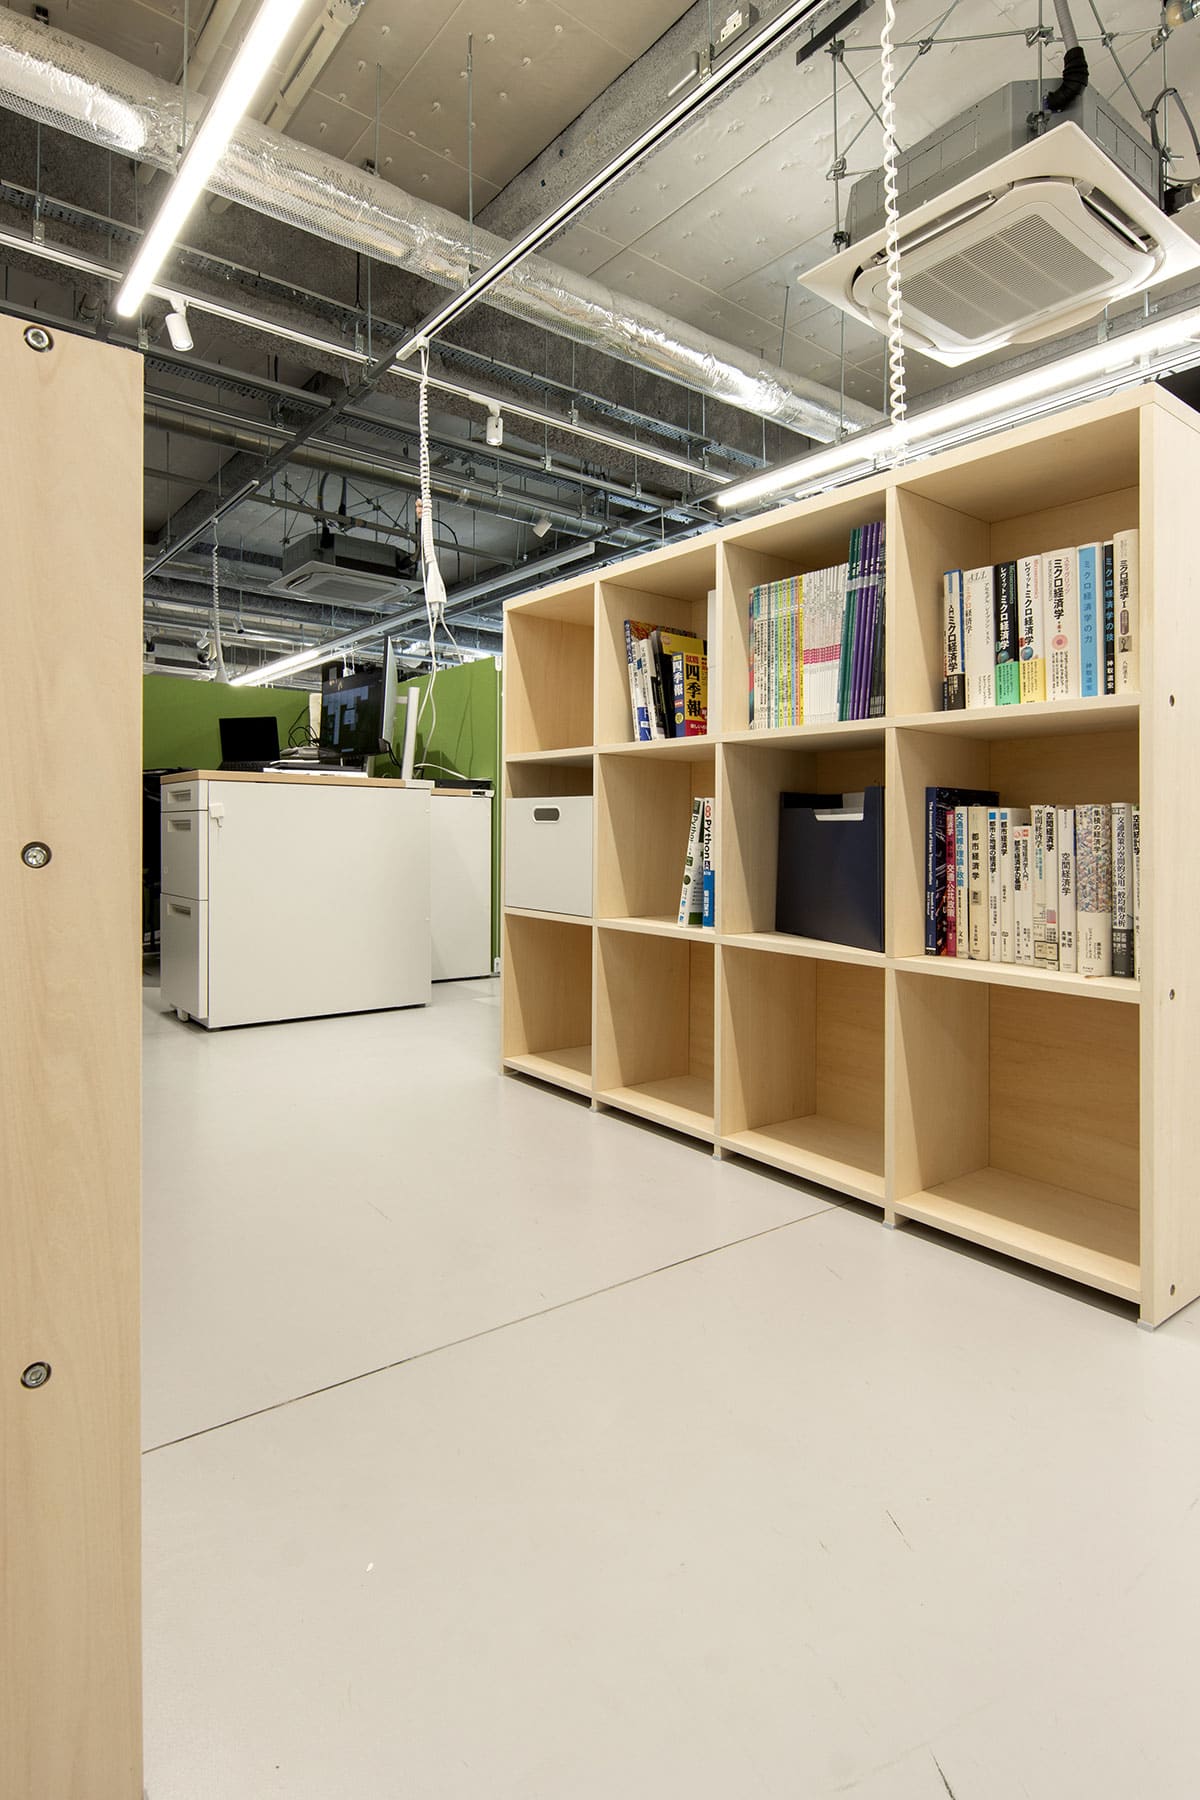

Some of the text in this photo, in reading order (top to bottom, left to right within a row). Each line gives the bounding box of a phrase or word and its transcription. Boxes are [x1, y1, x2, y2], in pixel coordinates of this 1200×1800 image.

[967, 570, 988, 583] ALL
[1053, 559, 1065, 620] ミクロ経済学
[1000, 595, 1010, 650] ミクロ経済学
[1024, 590, 1034, 646] ミクロ経済学
[1083, 560, 1093, 643] ミクロ経済学の力
[947, 605, 959, 673] 入門ミクロ経済学
[672, 660, 684, 697] 四季報
[685, 664, 702, 717] 四季報
[704, 819, 712, 860] Python
[1000, 820, 1008, 856] 都市経済学
[1045, 811, 1054, 852] 空間経済学
[1093, 809, 1101, 854] 集積の経済学
[971, 832, 980, 880] 都市経済学
[1061, 852, 1071, 896] 空間経済学
